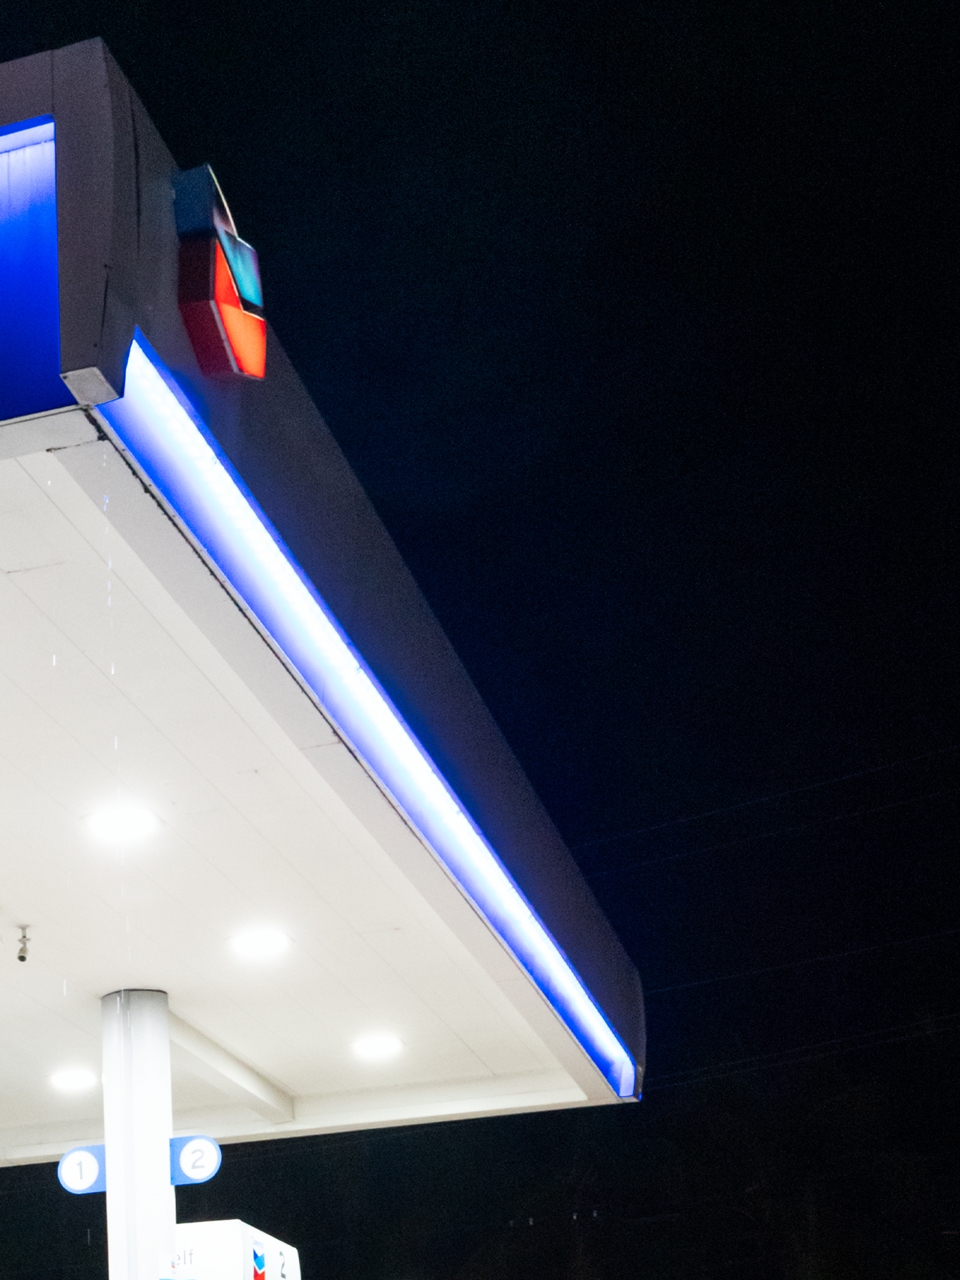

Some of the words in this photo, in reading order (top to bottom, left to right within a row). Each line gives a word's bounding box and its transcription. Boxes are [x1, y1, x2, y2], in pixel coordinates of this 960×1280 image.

[191, 1149, 205, 1169] 2
[76, 1160, 83, 1180] 1
[279, 1251, 287, 1279] 2
